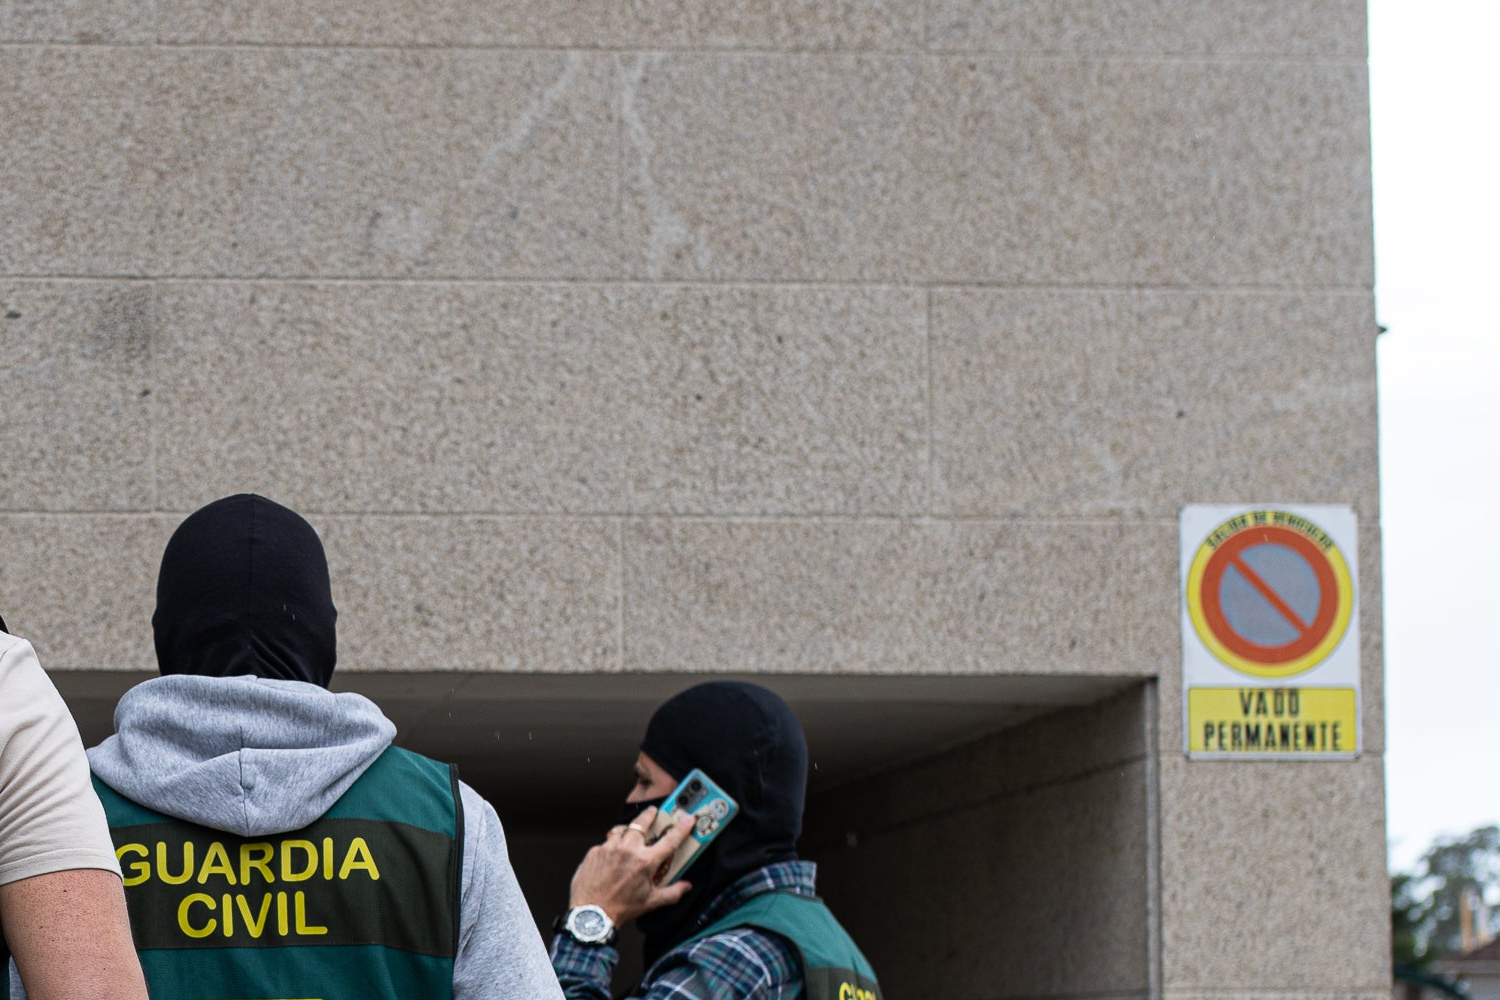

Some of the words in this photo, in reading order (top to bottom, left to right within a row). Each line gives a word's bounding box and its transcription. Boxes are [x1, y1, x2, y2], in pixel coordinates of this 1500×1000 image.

[1239, 687, 1300, 717] VADO
[1203, 720, 1341, 751] PERMANENTE
[115, 838, 379, 886] GUARDIA
[178, 891, 328, 938] CIVIL
